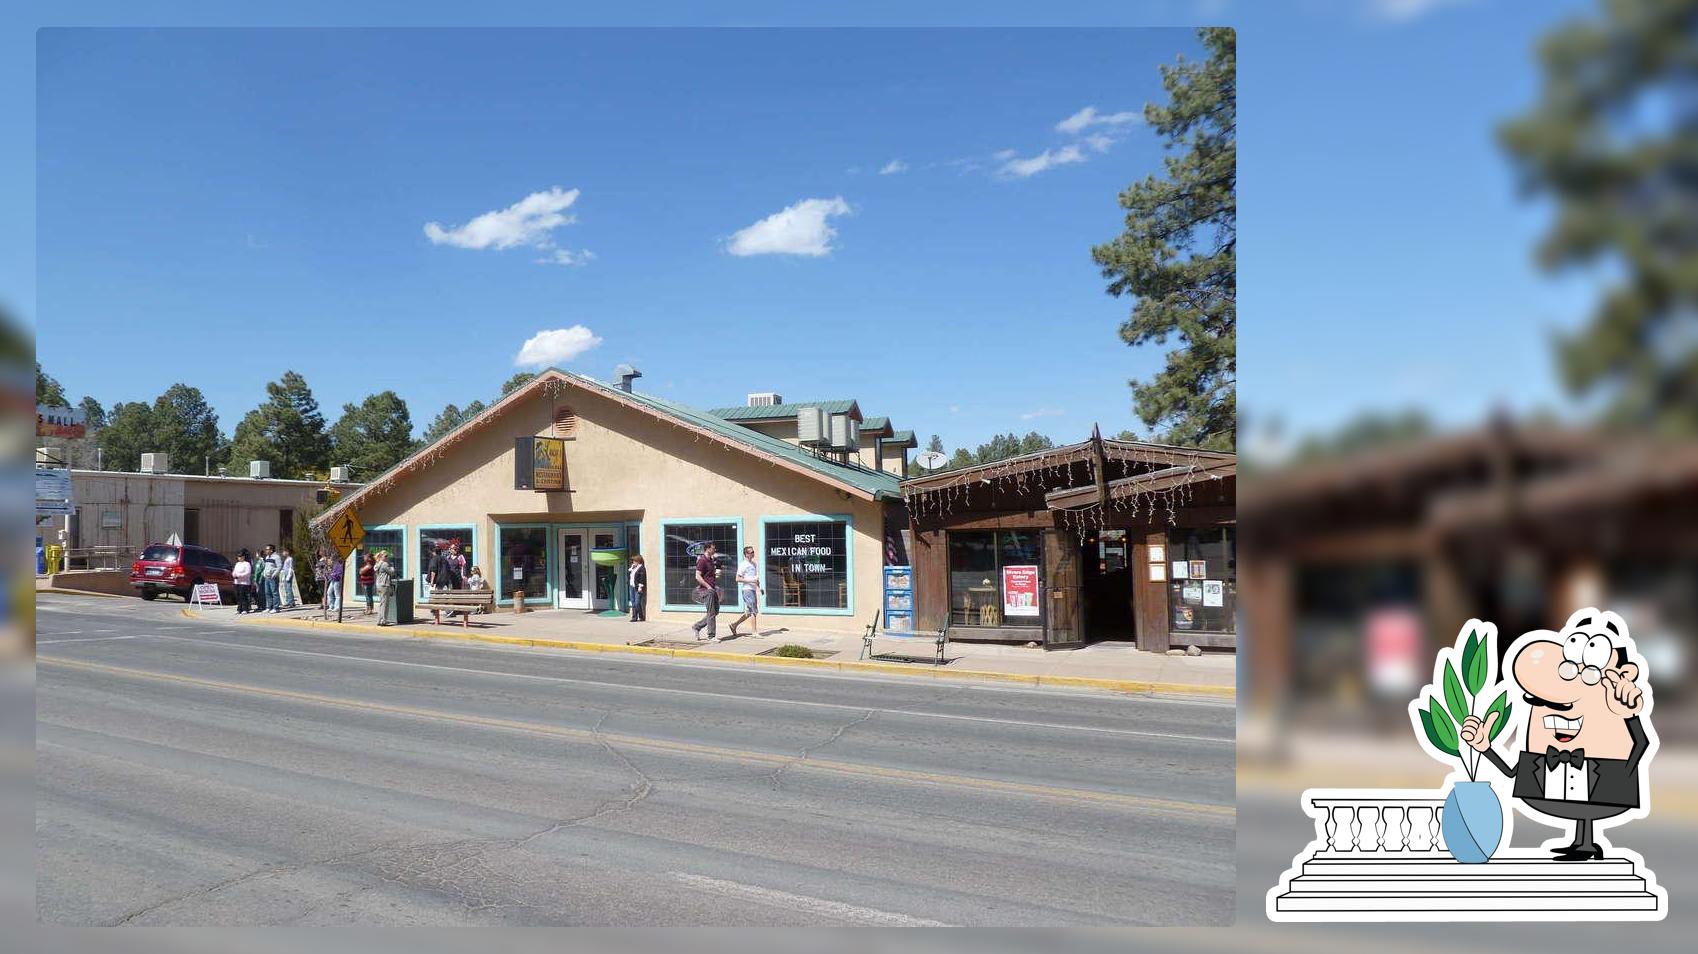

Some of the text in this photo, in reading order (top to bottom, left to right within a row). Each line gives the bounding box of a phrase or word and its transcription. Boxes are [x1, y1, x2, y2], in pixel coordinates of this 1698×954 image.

[48, 415, 76, 426] MALL
[795, 534, 816, 543] BEST
[770, 546, 832, 556] MEXICAN FOOD
[791, 563, 826, 573] IN TOWN
